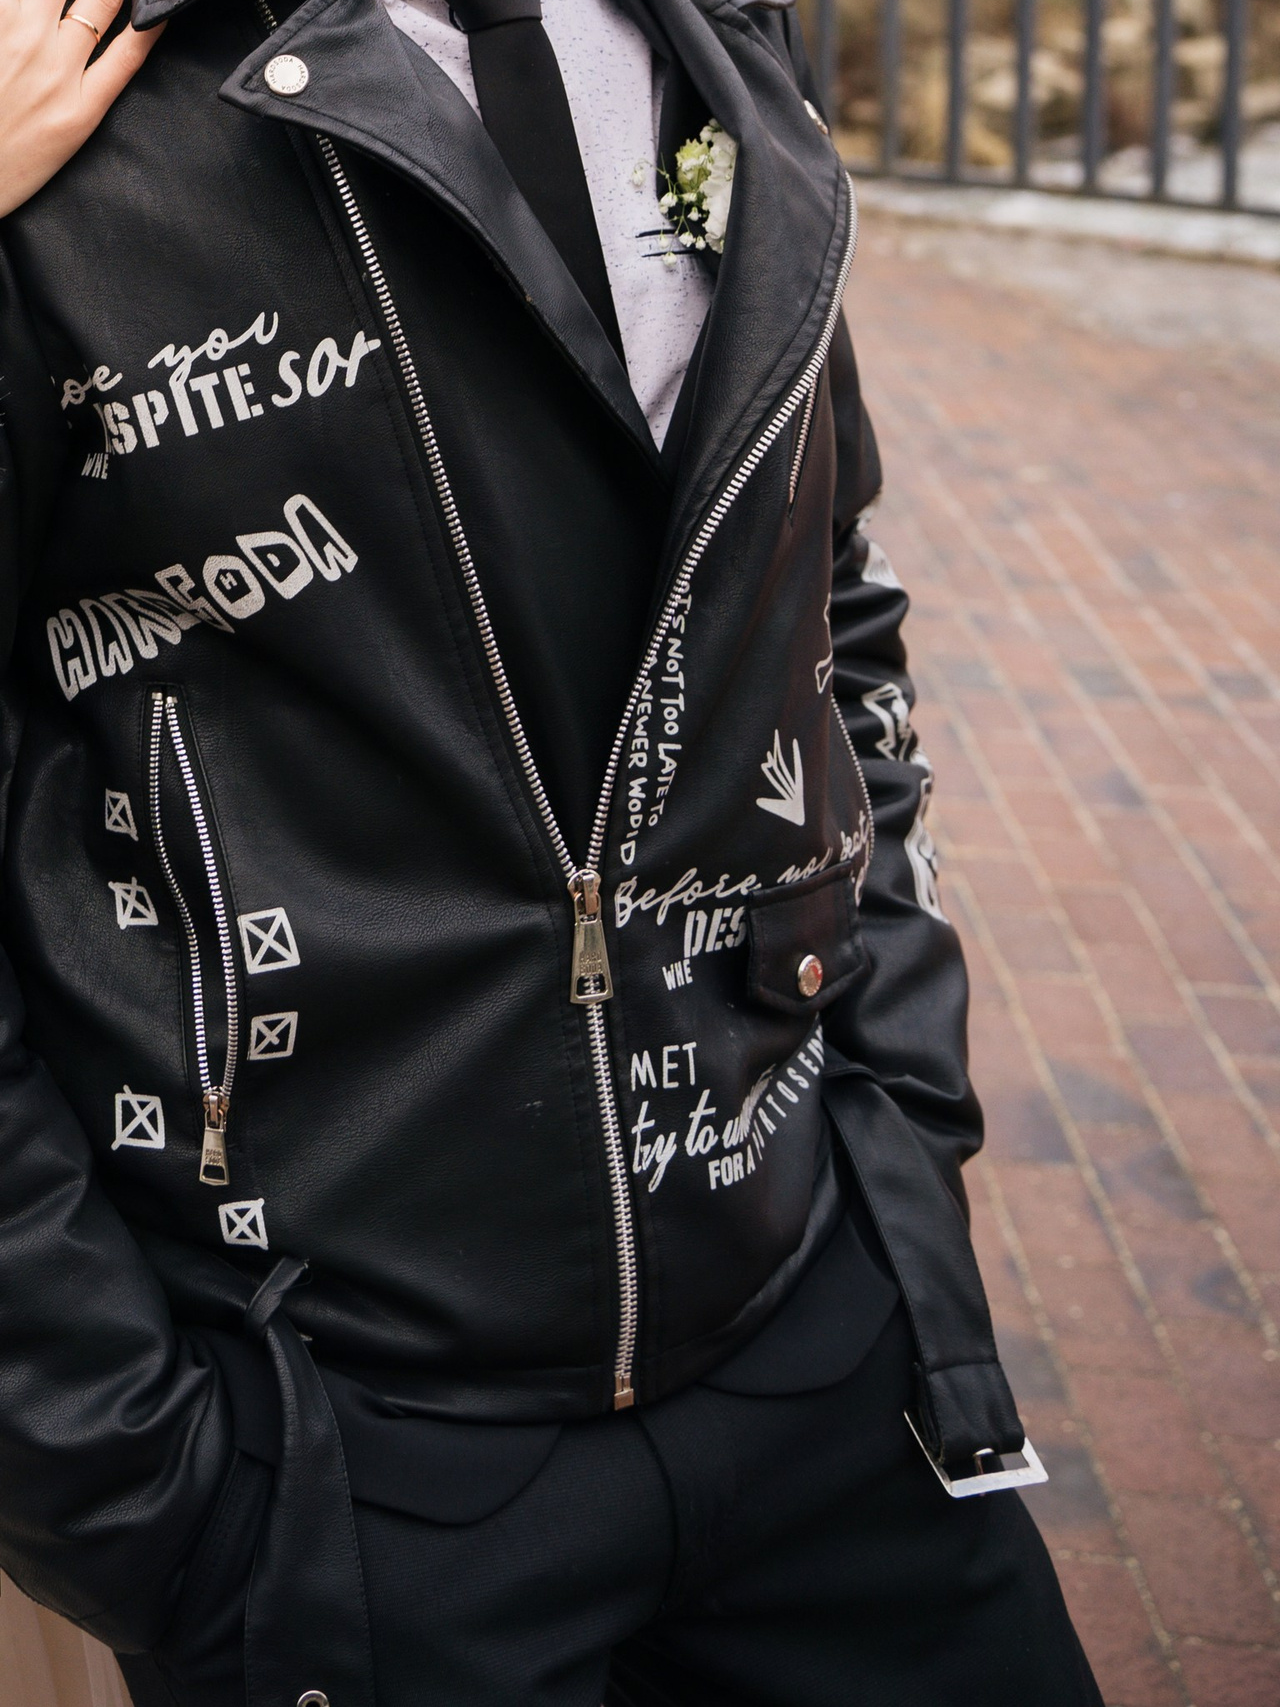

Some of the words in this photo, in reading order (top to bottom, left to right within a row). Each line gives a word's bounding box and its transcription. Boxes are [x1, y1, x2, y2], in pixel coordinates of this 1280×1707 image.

[667, 637, 685, 690] NOT
[628, 679, 654, 769] NEWER
[660, 692, 685, 735] TOO
[656, 742, 682, 798] LATE
[648, 798, 665, 827] TO
[631, 1041, 697, 1092] MET
[631, 1100, 678, 1193] try
[685, 1089, 719, 1157] to
